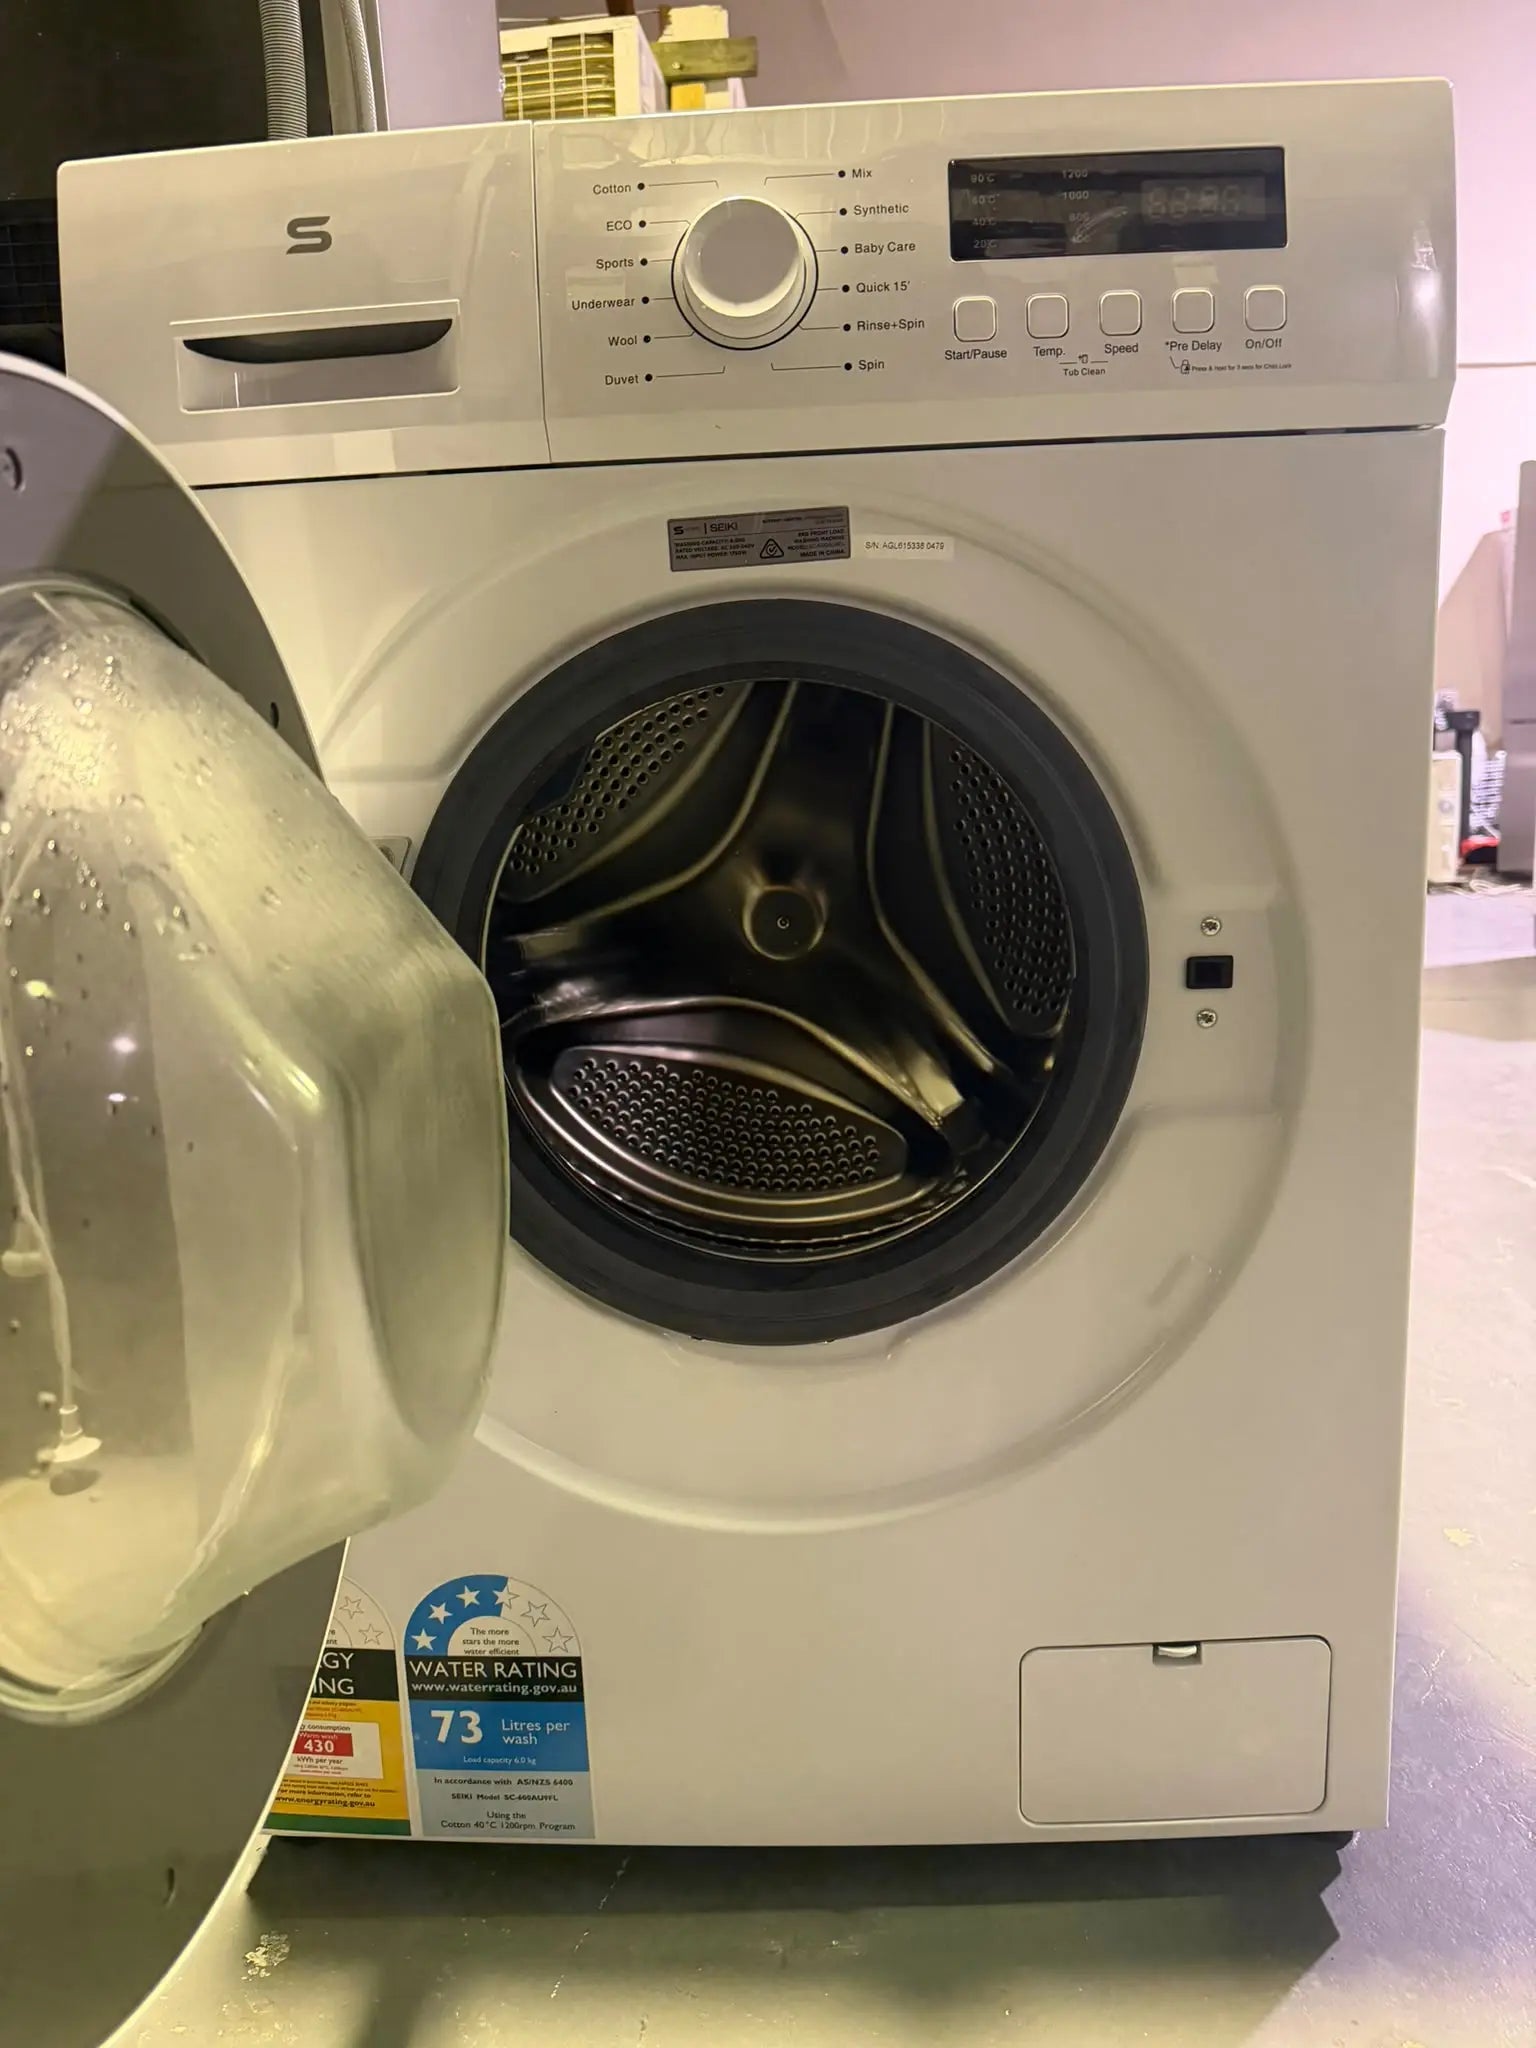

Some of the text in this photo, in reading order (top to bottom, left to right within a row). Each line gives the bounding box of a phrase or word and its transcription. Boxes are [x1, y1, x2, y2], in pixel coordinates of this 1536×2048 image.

[851, 168, 873, 180] Mix
[1062, 169, 1089, 179] 1200
[592, 183, 632, 195] Cotton
[1063, 190, 1089, 200] 1000
[853, 202, 910, 217] Synthetic
[606, 220, 633, 232] ECO
[286, 216, 332, 255] S
[854, 240, 916, 256] Baby Care
[596, 256, 634, 271] Sports
[856, 281, 889, 295] Quick
[571, 296, 636, 312] Underwear
[856, 317, 925, 333] Rinse+Spin
[607, 335, 638, 347] Wool
[1191, 338, 1223, 353] Delay
[1245, 337, 1283, 350] On/Off
[944, 348, 1008, 362] Start/Pause
[1033, 345, 1067, 360] Temp.
[1104, 342, 1139, 356] Speed
[858, 358, 885, 372] Spin
[1062, 367, 1107, 378] Tub Clean
[604, 373, 639, 386] Duvet
[710, 522, 738, 533] SEIKI
[470, 1627, 510, 1637] The more
[462, 1638, 520, 1647] stars the more
[463, 1647, 520, 1656] water efficient
[409, 1660, 578, 1680] WATER RATING
[411, 1682, 578, 1696] www.waterrating.gov.au
[431, 1709, 483, 1744] 73
[502, 1719, 570, 1735] Litres per
[304, 1739, 334, 1753] 430
[502, 1733, 538, 1746] wash
[463, 1756, 536, 1766] Load capacity 6.0 kg
[444, 1777, 492, 1785] accordance
[494, 1778, 512, 1786] with
[517, 1778, 551, 1786] AS/NZS
[553, 1778, 573, 1787] 6400
[476, 1793, 500, 1801] Model
[487, 1811, 511, 1820] Using
[440, 1820, 471, 1829] Cotton
[500, 1821, 536, 1831] 1200rpm
[539, 1821, 576, 1832] Program
